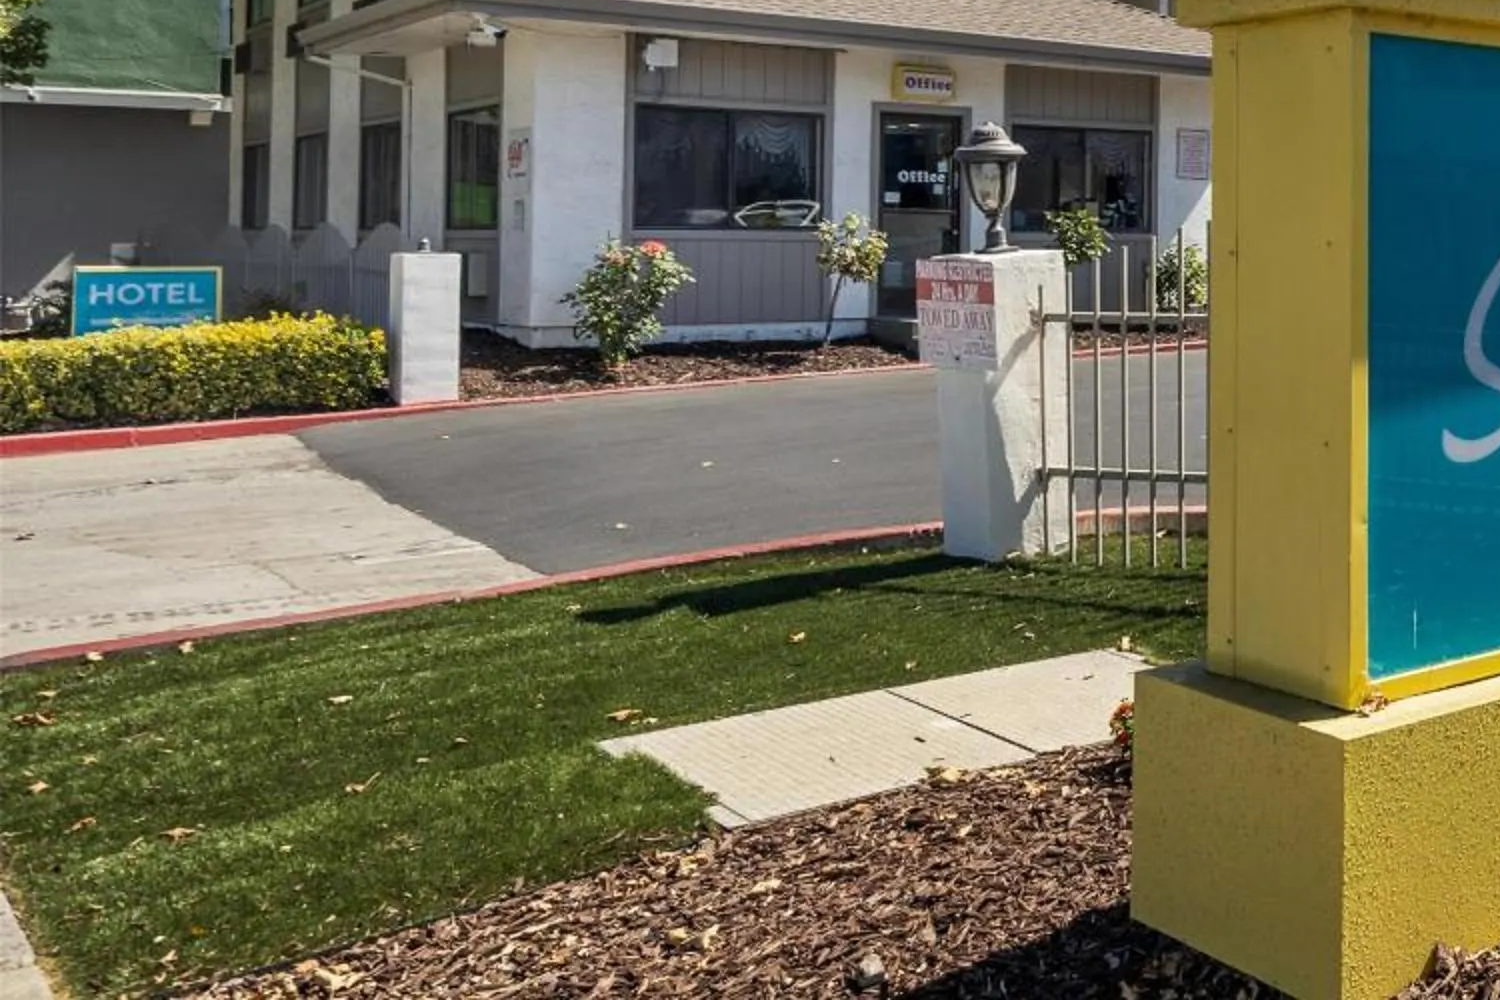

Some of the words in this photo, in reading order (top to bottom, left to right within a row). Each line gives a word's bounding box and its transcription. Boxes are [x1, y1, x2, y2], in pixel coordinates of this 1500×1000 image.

[904, 76, 951, 91] Office
[897, 169, 946, 183] Office
[89, 282, 205, 305] HOTEL
[920, 307, 960, 328] TOWED
[963, 311, 993, 332] AWAY
